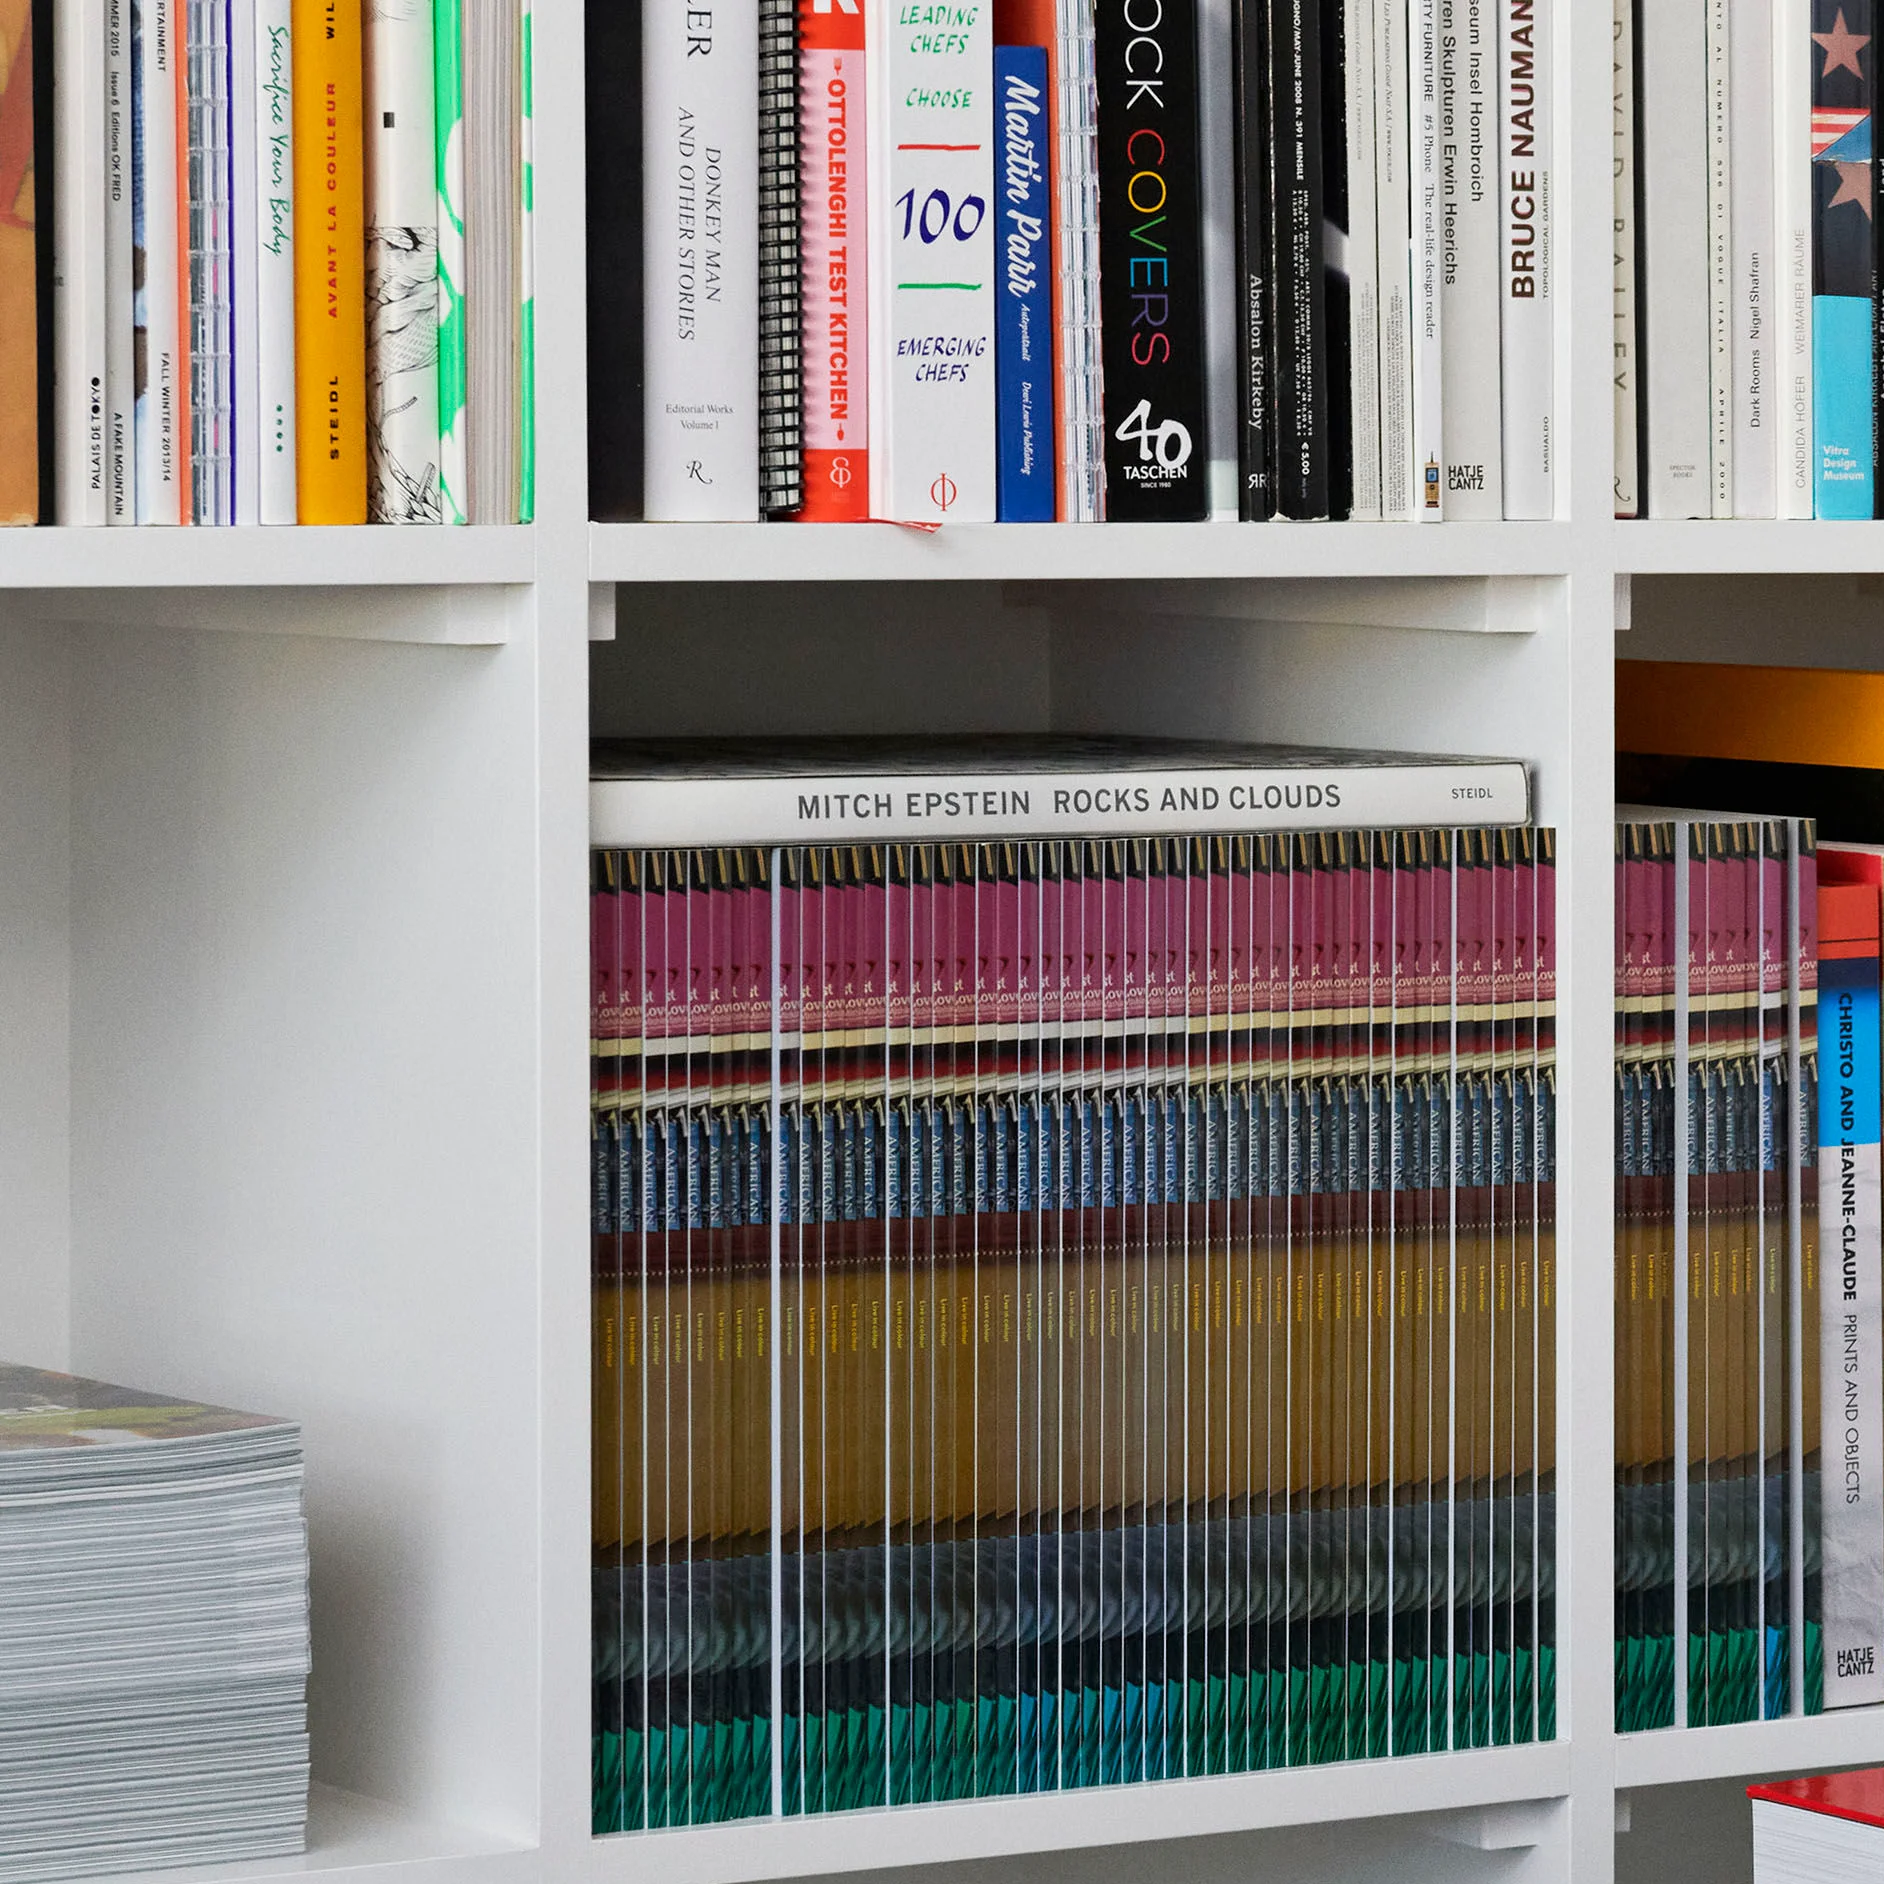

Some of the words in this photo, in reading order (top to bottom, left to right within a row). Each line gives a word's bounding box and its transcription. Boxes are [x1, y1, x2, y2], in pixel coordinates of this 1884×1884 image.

[900, 6, 979, 27] LEADING
[910, 34, 969, 54] CHEFS
[1423, 23, 1433, 102] FURNITURE
[262, 24, 289, 126] Sacrifice
[906, 88, 973, 109] CHOOSE
[1441, 35, 1457, 138] Skulpturen
[1470, 52, 1483, 95] Insel
[1510, 0, 1535, 158] NAUMAN
[326, 82, 337, 191] COULEUR
[678, 106, 696, 158] AND
[1005, 75, 1042, 204] Martin
[1424, 135, 1434, 173] Phone
[1470, 101, 1484, 202] Hombroich
[268, 136, 291, 189] Your
[828, 79, 847, 238] OTTOLENGHI
[1296, 141, 1304, 181] MENSILE
[1443, 145, 1458, 196] Erwin
[112, 173, 121, 201] FRED
[678, 164, 696, 241] OTHER
[705, 147, 722, 244] DONKEY
[1425, 184, 1434, 198] The
[263, 198, 293, 257] Body
[328, 205, 337, 232] LA
[895, 187, 986, 245] 100
[1511, 171, 1535, 298] BRUCE
[1006, 209, 1042, 298] Parr
[1127, 129, 1171, 366] COVERS
[1444, 201, 1458, 285] Heerichs
[328, 247, 338, 318] AVANT
[678, 247, 696, 341] STORIES
[705, 250, 722, 302] MAN
[829, 246, 847, 307] TEST
[1423, 259, 1435, 298] design
[1749, 251, 1760, 304] Shafran
[1250, 274, 1264, 350] Absalon
[1425, 301, 1434, 339] reader
[1749, 308, 1762, 339] Nigel
[1793, 282, 1805, 354] WEIMARER
[161, 352, 169, 383] FALL
[829, 312, 848, 420] KITCHEN
[897, 337, 987, 357] EMERGING
[1750, 349, 1761, 394] Rooms
[915, 363, 969, 383] CHEFS
[1249, 355, 1265, 430] Kirkeby
[92, 425, 100, 442] DE
[162, 386, 171, 432] WINTER
[330, 376, 340, 460] STEIDL
[665, 404, 705, 415] Editorial
[706, 404, 734, 414] Works
[680, 420, 714, 430] Volume
[1115, 398, 1193, 470] 40
[1750, 402, 1761, 428] Dark
[115, 423, 123, 453] FAKE
[163, 436, 172, 482] 2013/14
[1795, 427, 1806, 488] CANDIDA
[1823, 445, 1849, 456] Vitra
[1823, 458, 1856, 469] Design
[92, 445, 100, 489] PALAIS
[115, 456, 124, 516] MOUNTAIN
[1123, 465, 1188, 480] TASCHEN
[1448, 465, 1484, 478] HATJE
[1448, 477, 1485, 490] CANTZ
[1823, 471, 1865, 481] Museum
[798, 793, 894, 820] MITCH
[905, 790, 1031, 817] EPSTEIN
[1053, 787, 1151, 815] ROCKS
[1160, 785, 1222, 813] AND
[1228, 783, 1342, 810] CLOUDS
[1450, 787, 1493, 800] STEIDL
[1838, 993, 1855, 1080] CHRISTO
[1840, 1085, 1855, 1132] AND
[1840, 1139, 1857, 1300] JEANNE-CLAUDE
[1844, 1314, 1857, 1374] PRINTS
[1845, 1379, 1859, 1422] AND
[1845, 1427, 1860, 1505] OBJECTS
[1837, 1646, 1875, 1664] HATJE
[1837, 1660, 1875, 1678] CANTZ
